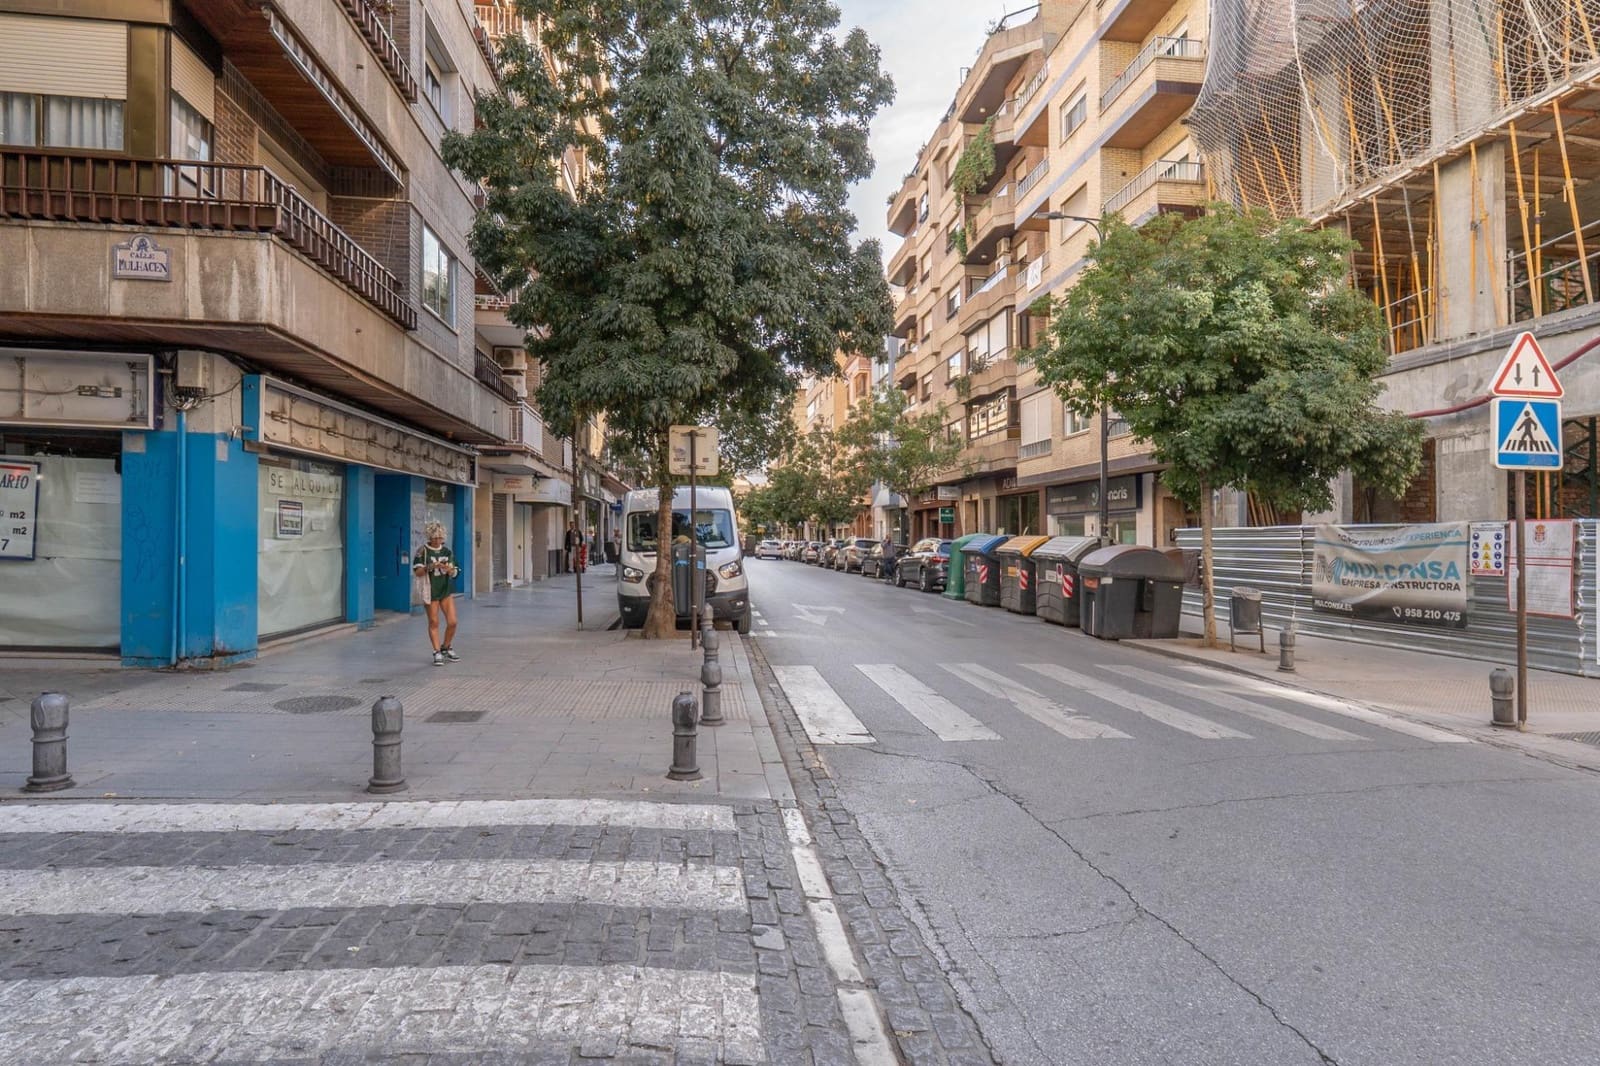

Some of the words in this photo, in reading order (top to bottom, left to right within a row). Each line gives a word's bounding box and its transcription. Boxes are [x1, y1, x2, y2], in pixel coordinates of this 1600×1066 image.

[270, 473, 284, 489] SE
[294, 477, 340, 494] ALQUILA
[9, 511, 26, 520] m2
[12, 526, 28, 536] m2
[1343, 560, 1461, 581] MULCONSA
[1341, 578, 1381, 590] EMPRESA
[1383, 580, 1461, 591] CNSTRUCTORA
[1404, 607, 1422, 618] 958
[1423, 609, 1441, 619] 210
[1443, 610, 1461, 621] 475
